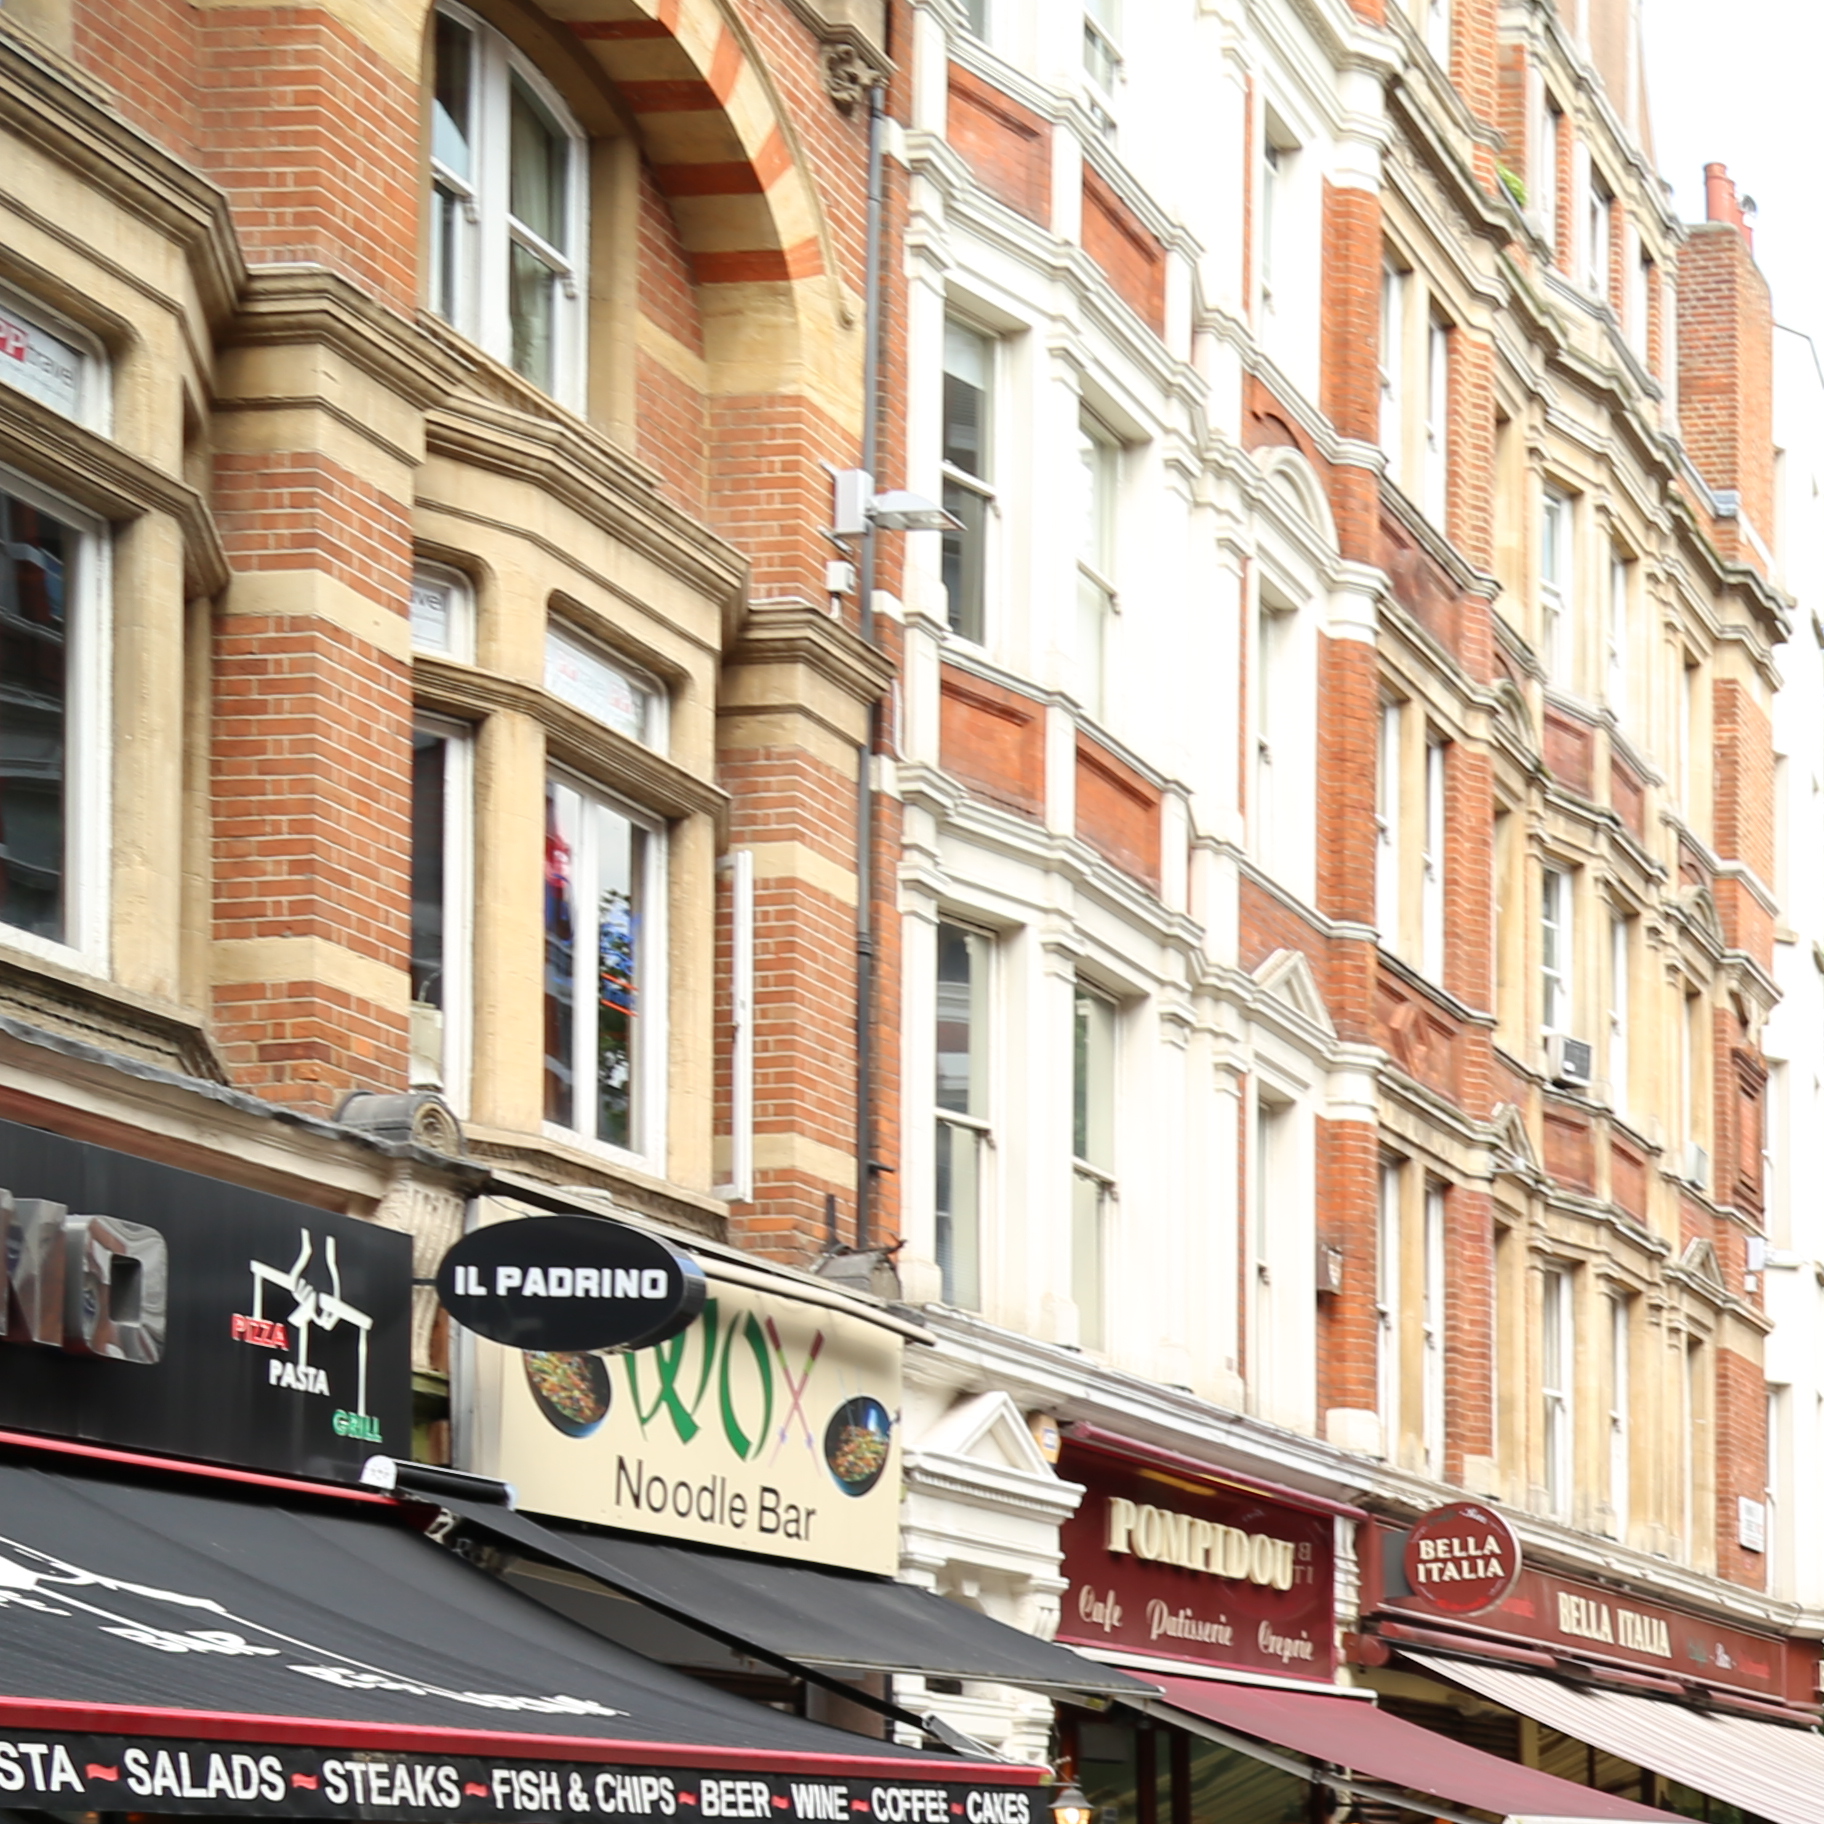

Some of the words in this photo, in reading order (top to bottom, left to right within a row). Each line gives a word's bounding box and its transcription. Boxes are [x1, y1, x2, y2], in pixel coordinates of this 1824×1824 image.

[454, 1266, 487, 1297] IL
[496, 1267, 668, 1300] PADRINO
[231, 1313, 290, 1351] PIZZA
[268, 1359, 330, 1396] PASTA
[332, 1409, 383, 1443] GRILL
[614, 1455, 749, 1530] Noodle
[757, 1486, 816, 1541] Bar
[1107, 1496, 1295, 1592] POMPIDOU
[1418, 1534, 1502, 1560] BELLA
[1417, 1557, 1505, 1584] ITALIA
[1147, 1598, 1234, 1647] Patisserie
[1557, 1592, 1615, 1645] BELLA
[1616, 1608, 1672, 1659] ITALIA
[124, 1747, 286, 1801] SALADS
[323, 1763, 461, 1809] STEAKS
[491, 1769, 561, 1811] FISH
[568, 1780, 590, 1811] &
[596, 1774, 677, 1815] CHIPS
[700, 1779, 772, 1818] BEER
[791, 1783, 850, 1822] WINE
[871, 1786, 950, 1824] COFFEE
